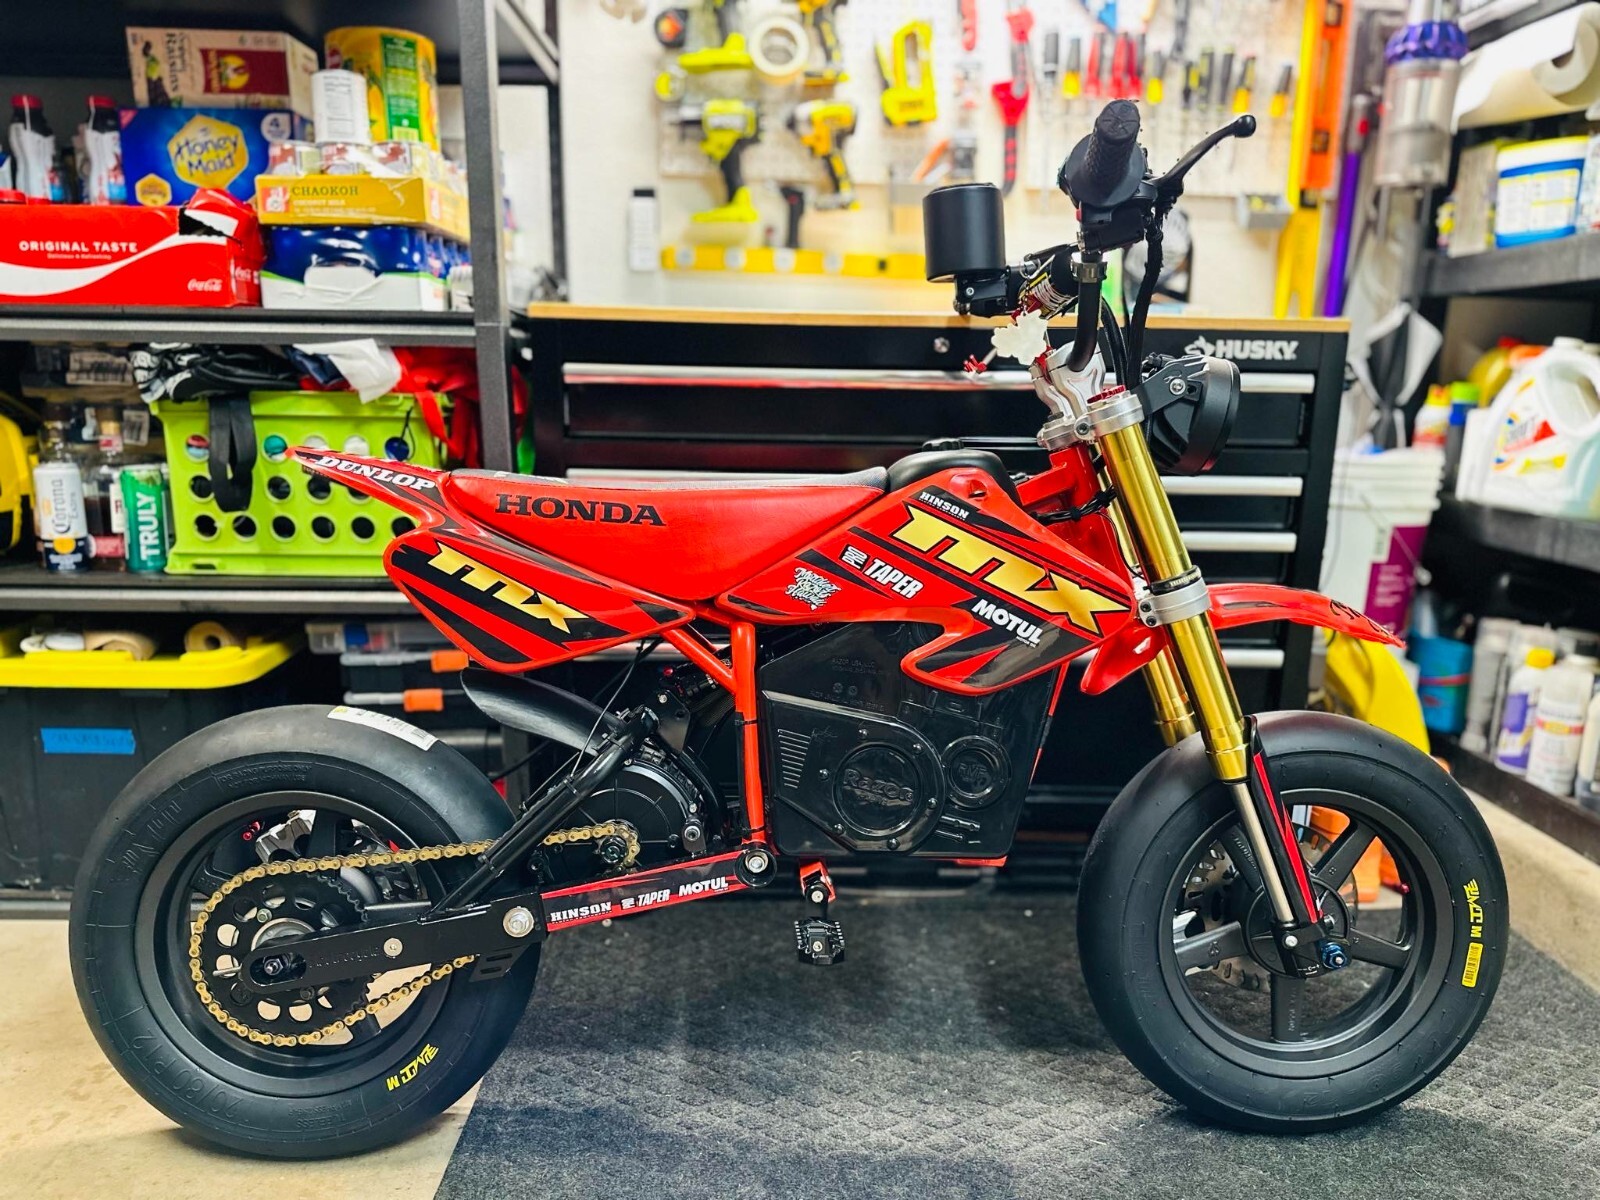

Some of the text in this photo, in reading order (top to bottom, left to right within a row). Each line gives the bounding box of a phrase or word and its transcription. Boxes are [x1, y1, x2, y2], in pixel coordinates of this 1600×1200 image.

[175, 136, 238, 161] Honey
[187, 153, 235, 177] Maid
[291, 185, 359, 196] CHAOKOH
[19, 240, 138, 253] ORIGINAL TASTE
[1215, 339, 1299, 360] HUSKY
[315, 456, 436, 491] DUNLOP
[52, 479, 71, 534] Corona
[495, 494, 667, 527] HONDA
[919, 491, 970, 519] HINSON
[136, 491, 160, 561] TRULY
[863, 559, 924, 599] TAPER
[971, 598, 1044, 644] MOTUL
[550, 901, 612, 922] HINSON
[637, 889, 671, 908] TAPER
[679, 876, 729, 897] MOTUL
